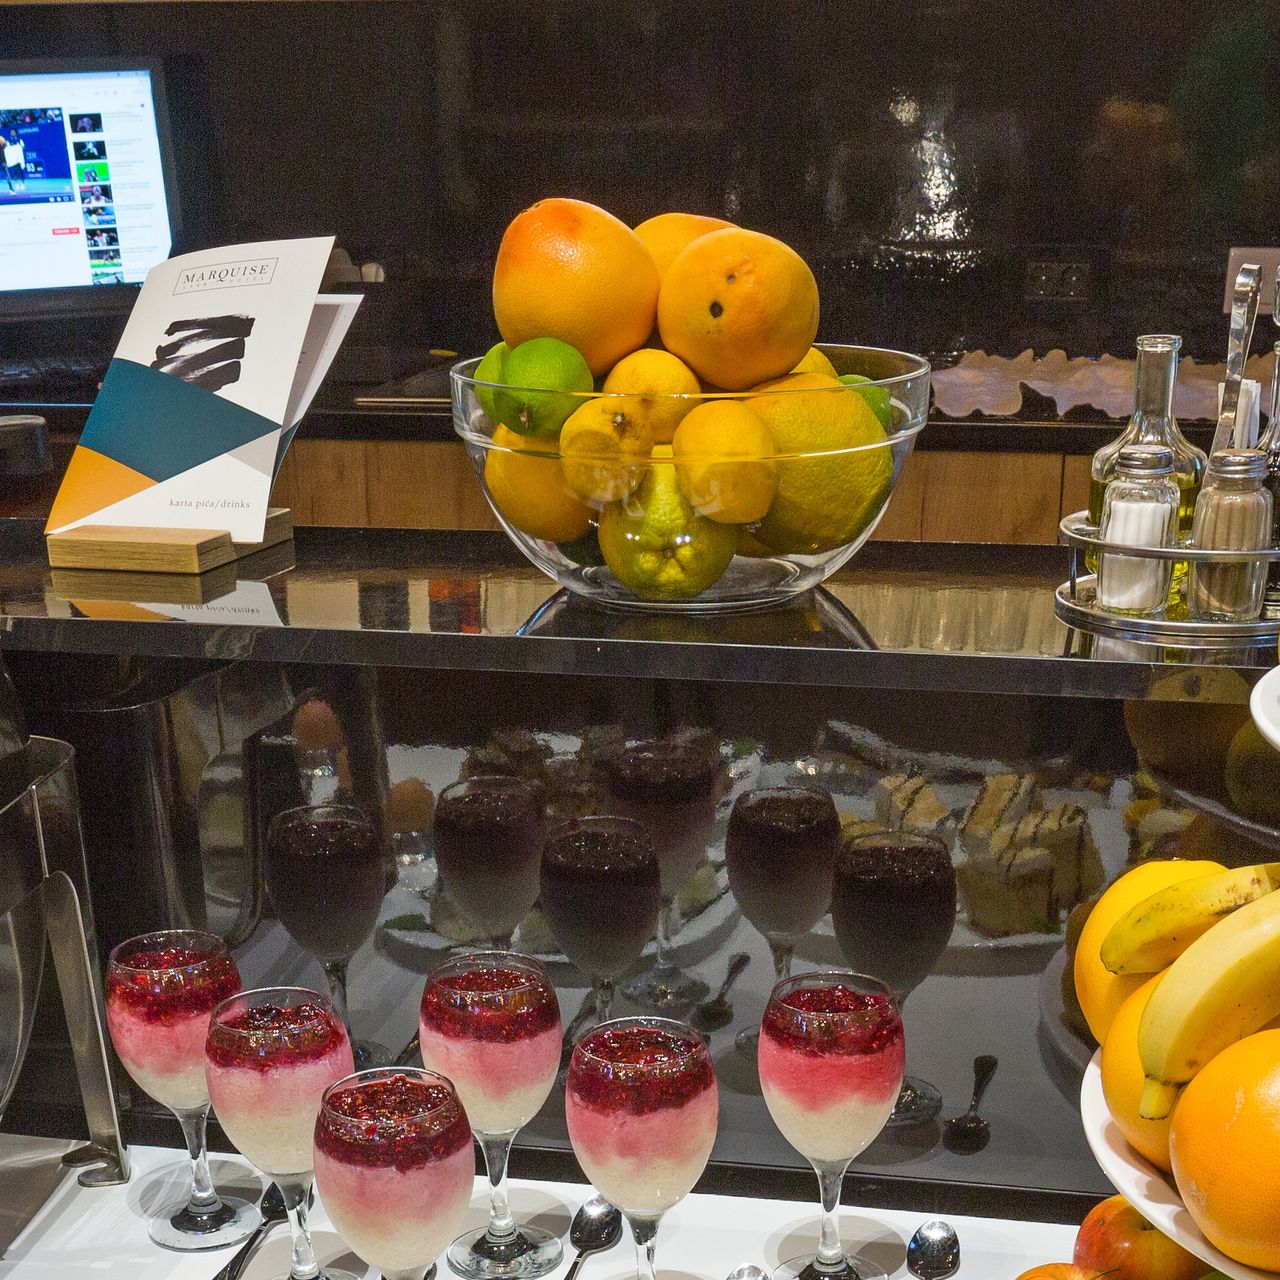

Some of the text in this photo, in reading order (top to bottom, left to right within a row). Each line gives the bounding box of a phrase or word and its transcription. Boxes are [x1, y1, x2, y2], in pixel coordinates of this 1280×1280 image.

[182, 264, 270, 283] MARQUISE
[169, 497, 251, 510] karta pića/drinks
